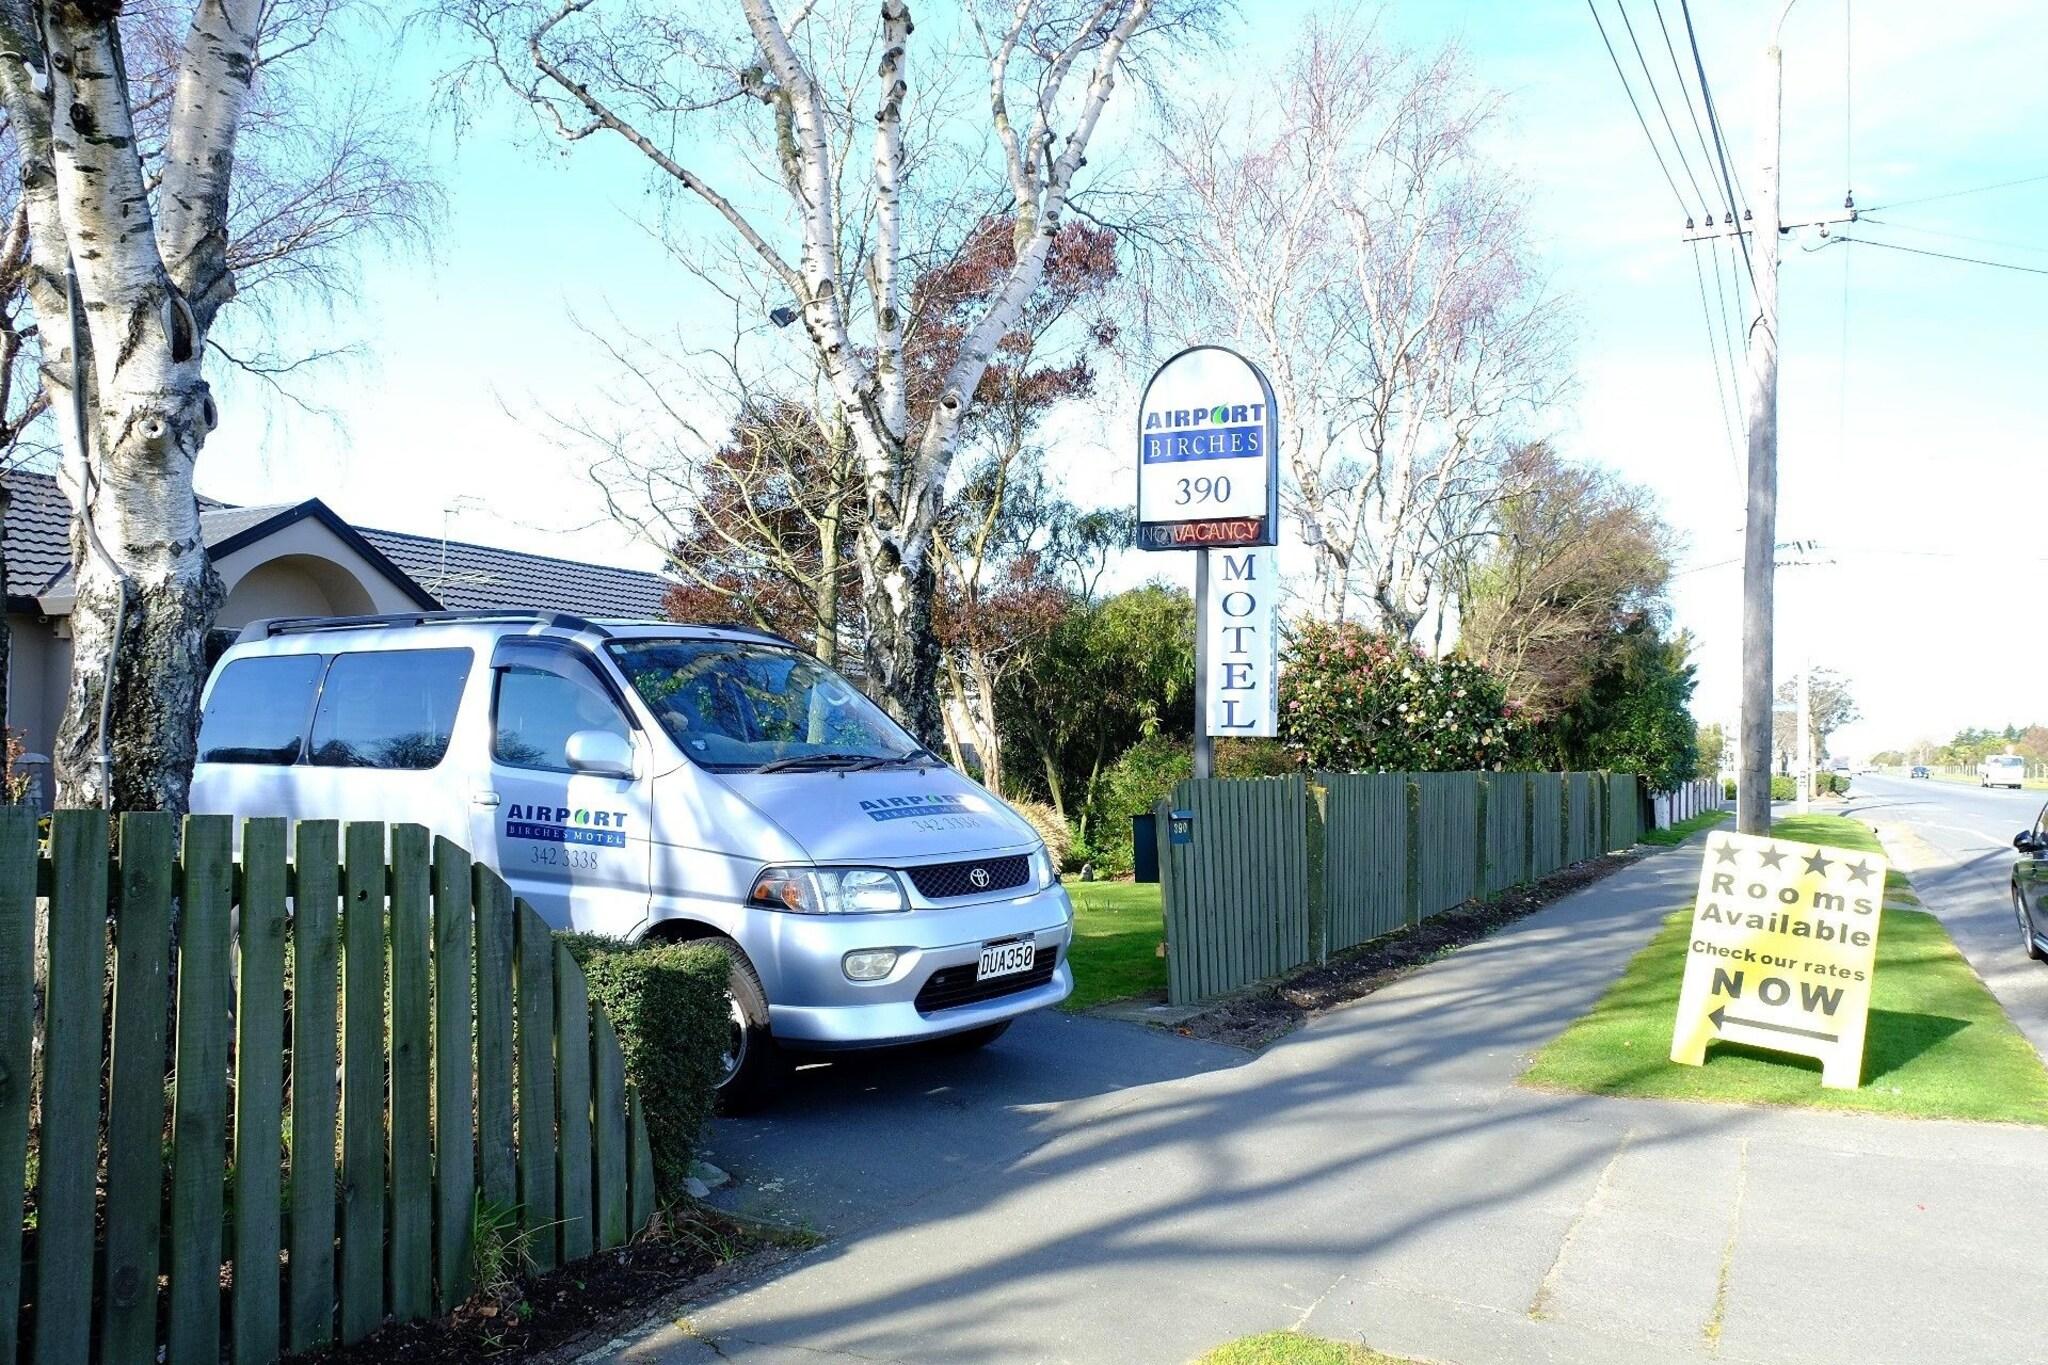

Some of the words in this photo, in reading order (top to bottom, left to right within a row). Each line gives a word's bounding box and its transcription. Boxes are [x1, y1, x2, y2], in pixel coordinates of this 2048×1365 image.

[1145, 403, 1264, 430] AIRPORT
[1150, 432, 1258, 458] BIRCHES
[1174, 475, 1231, 505] 390
[1173, 521, 1259, 542] VACANCY
[1220, 554, 1257, 728] MOTEL
[507, 803, 628, 828] AIRPORT
[509, 826, 568, 839] BIRCHES
[573, 831, 623, 845] MOTEL
[530, 846, 557, 865] 342
[562, 849, 598, 870] 3338
[1711, 872, 1873, 916] Rooms
[1700, 902, 1871, 947] Available
[981, 946, 1033, 975] DUA350
[1692, 940, 1756, 963] Check
[1760, 954, 1798, 969] our
[1804, 961, 1865, 982] rates
[1711, 967, 1844, 1017] NOW
